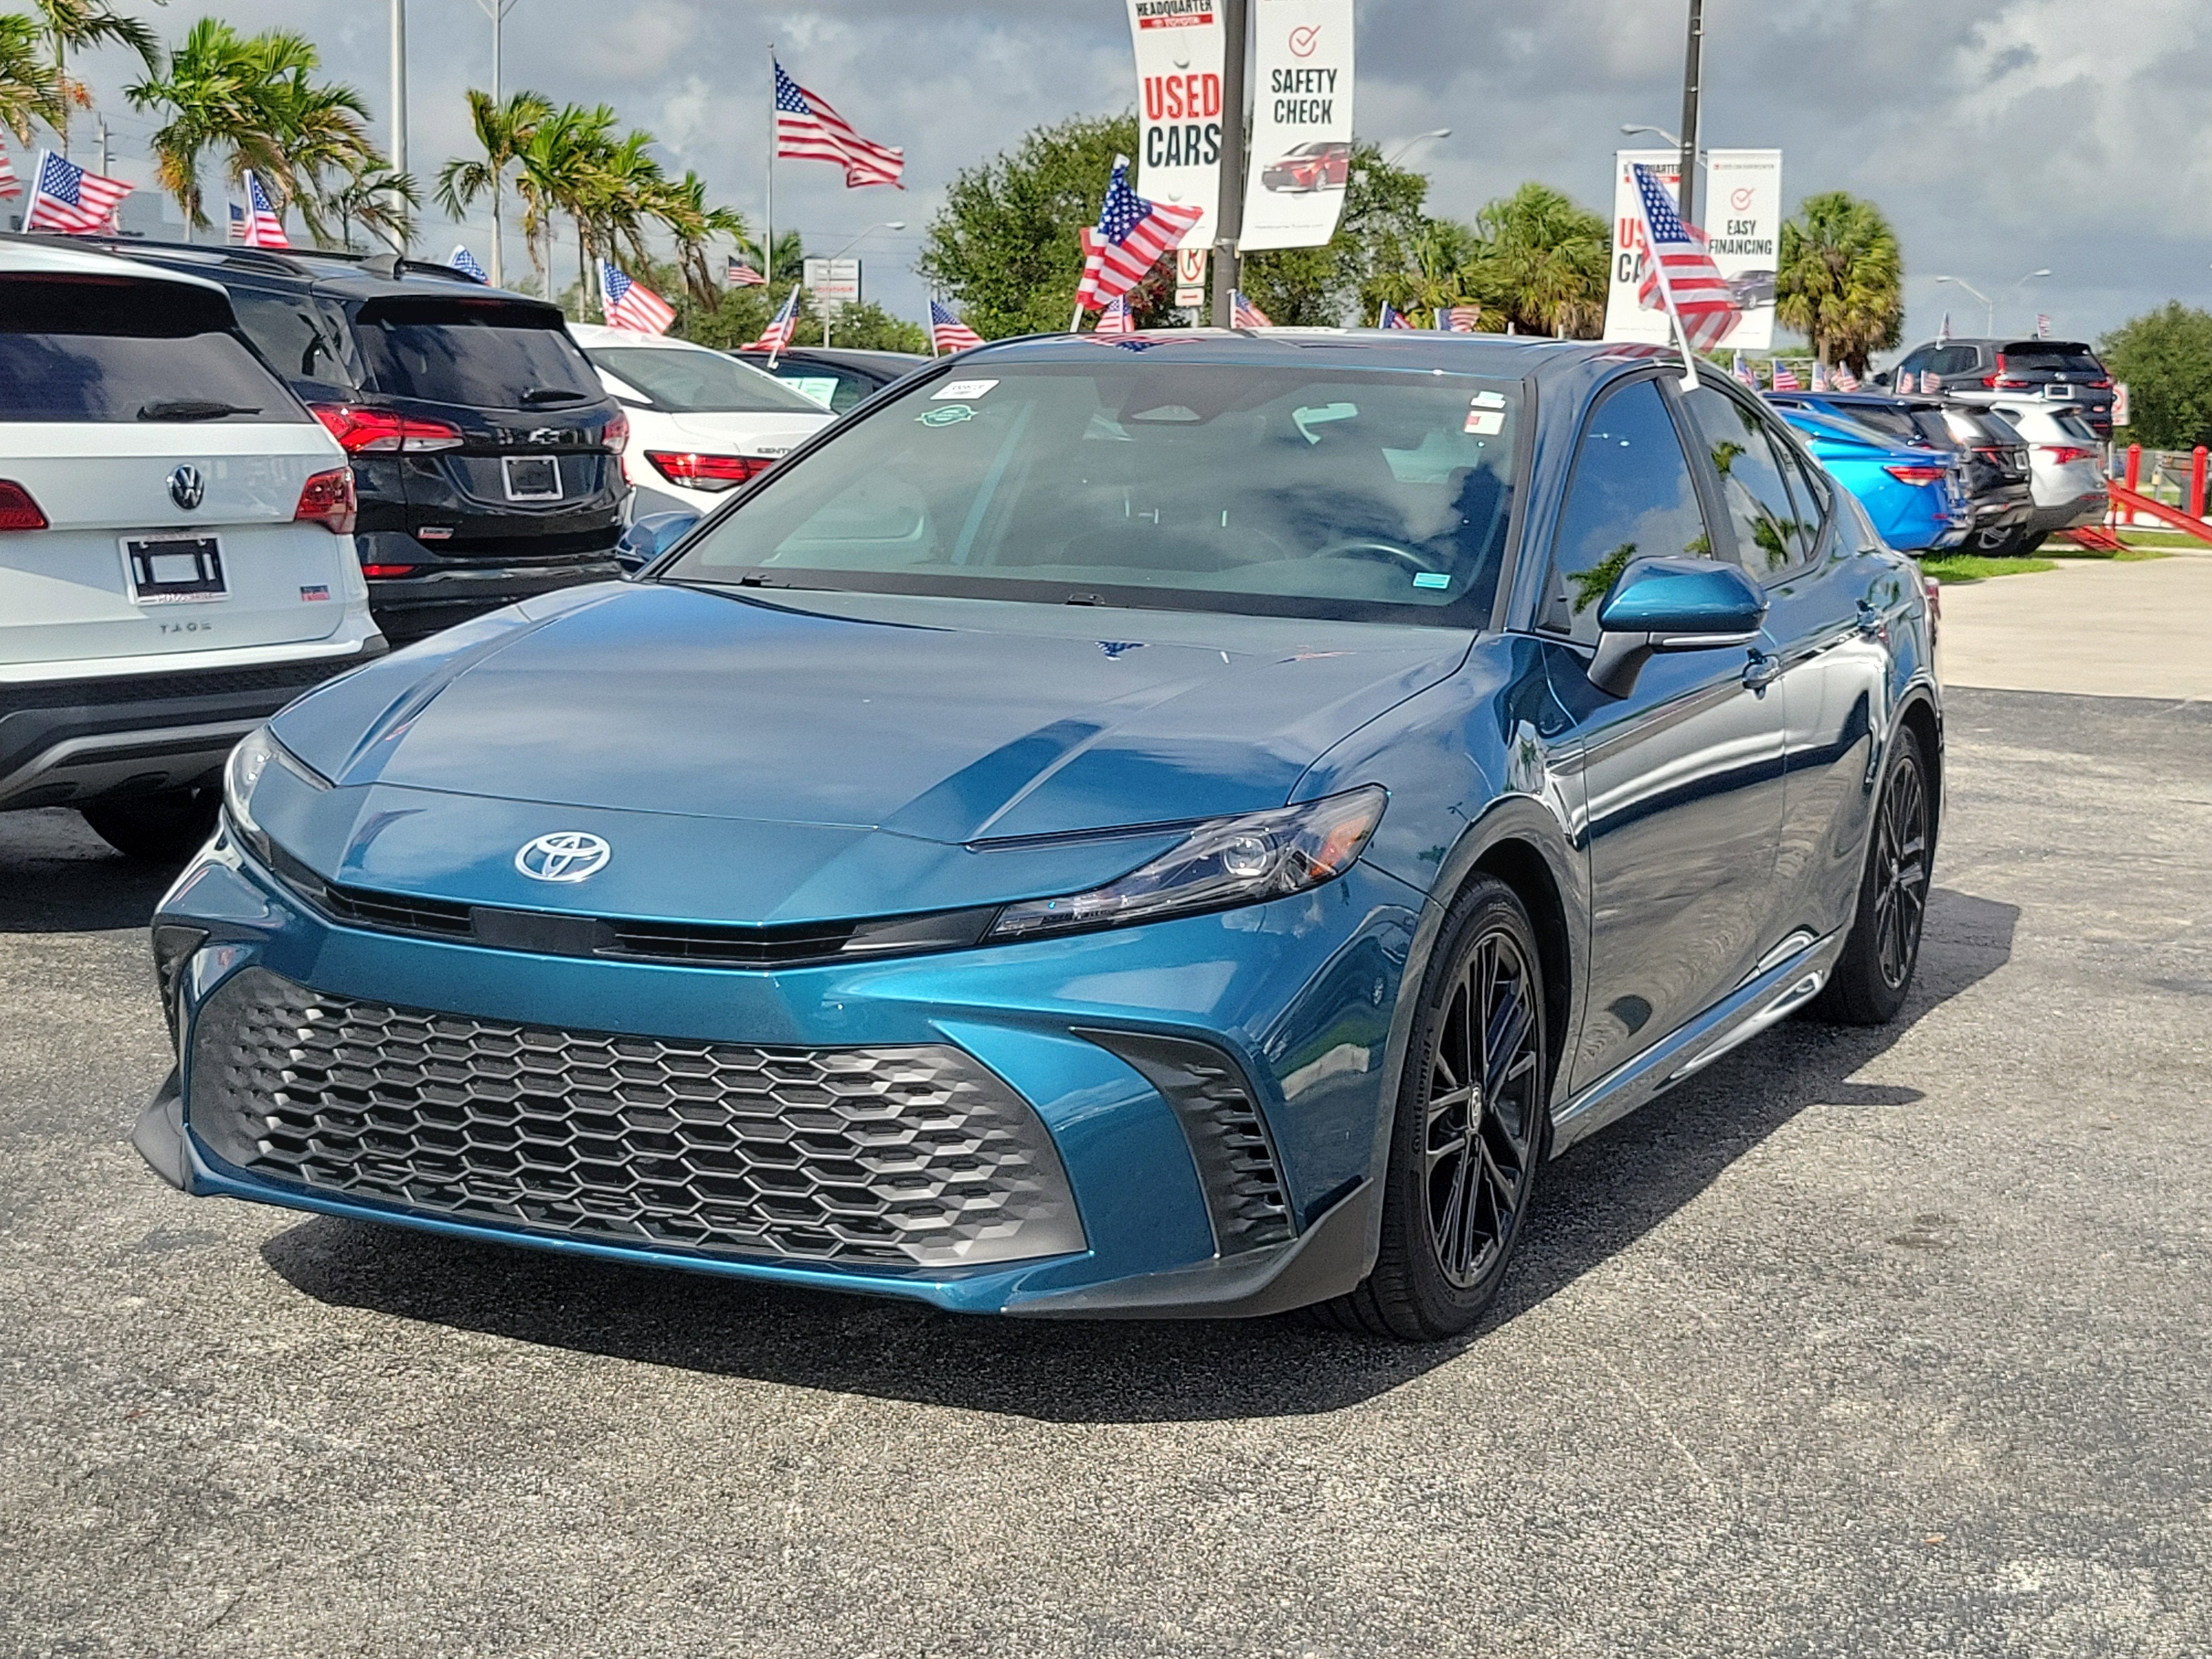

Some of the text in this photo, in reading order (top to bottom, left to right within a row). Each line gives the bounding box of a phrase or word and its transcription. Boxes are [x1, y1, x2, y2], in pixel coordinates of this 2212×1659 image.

[1136, 0, 1213, 16] HEADQUARTER
[1271, 68, 1338, 93] SAFETY
[1144, 73, 1220, 121] USED
[1274, 99, 1333, 125] CHECK
[1147, 123, 1221, 168] CARS
[1727, 219, 1757, 236] EASY
[1708, 239, 1773, 255] FINANCING
